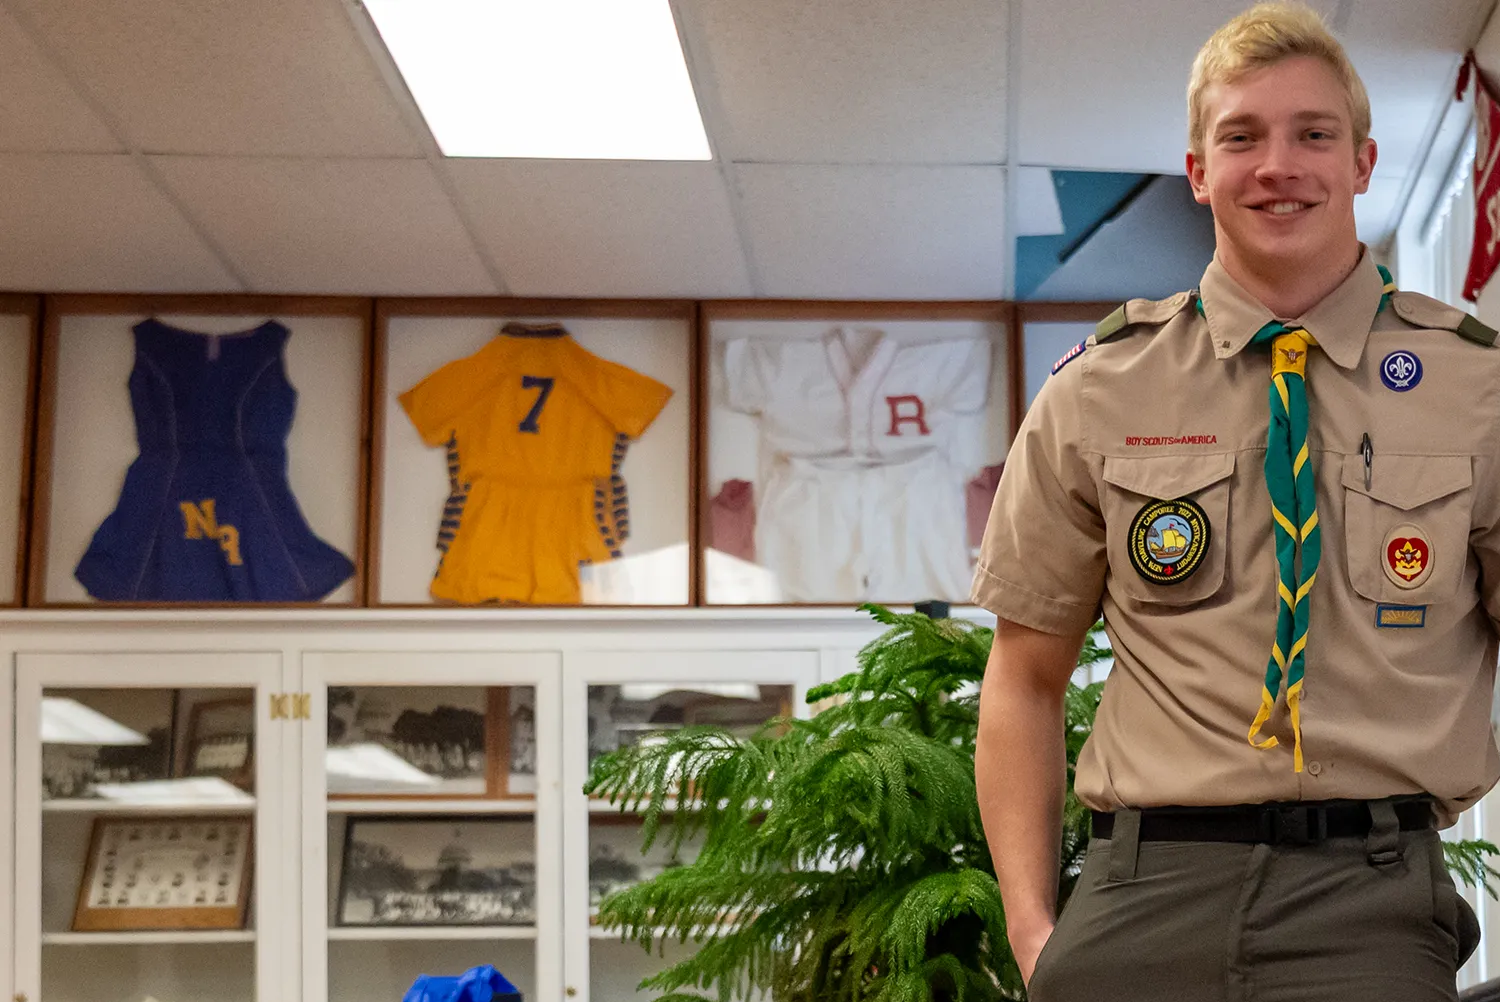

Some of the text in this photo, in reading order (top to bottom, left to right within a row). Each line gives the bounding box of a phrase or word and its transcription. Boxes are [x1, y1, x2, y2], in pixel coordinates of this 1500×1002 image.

[519, 376, 555, 434] 7
[884, 394, 932, 437] R
[1126, 436, 1142, 446] BOY
[1142, 436, 1174, 446] SCOUTS
[1180, 434, 1217, 445] AMERICA
[1143, 505, 1175, 526] CAMPOREE
